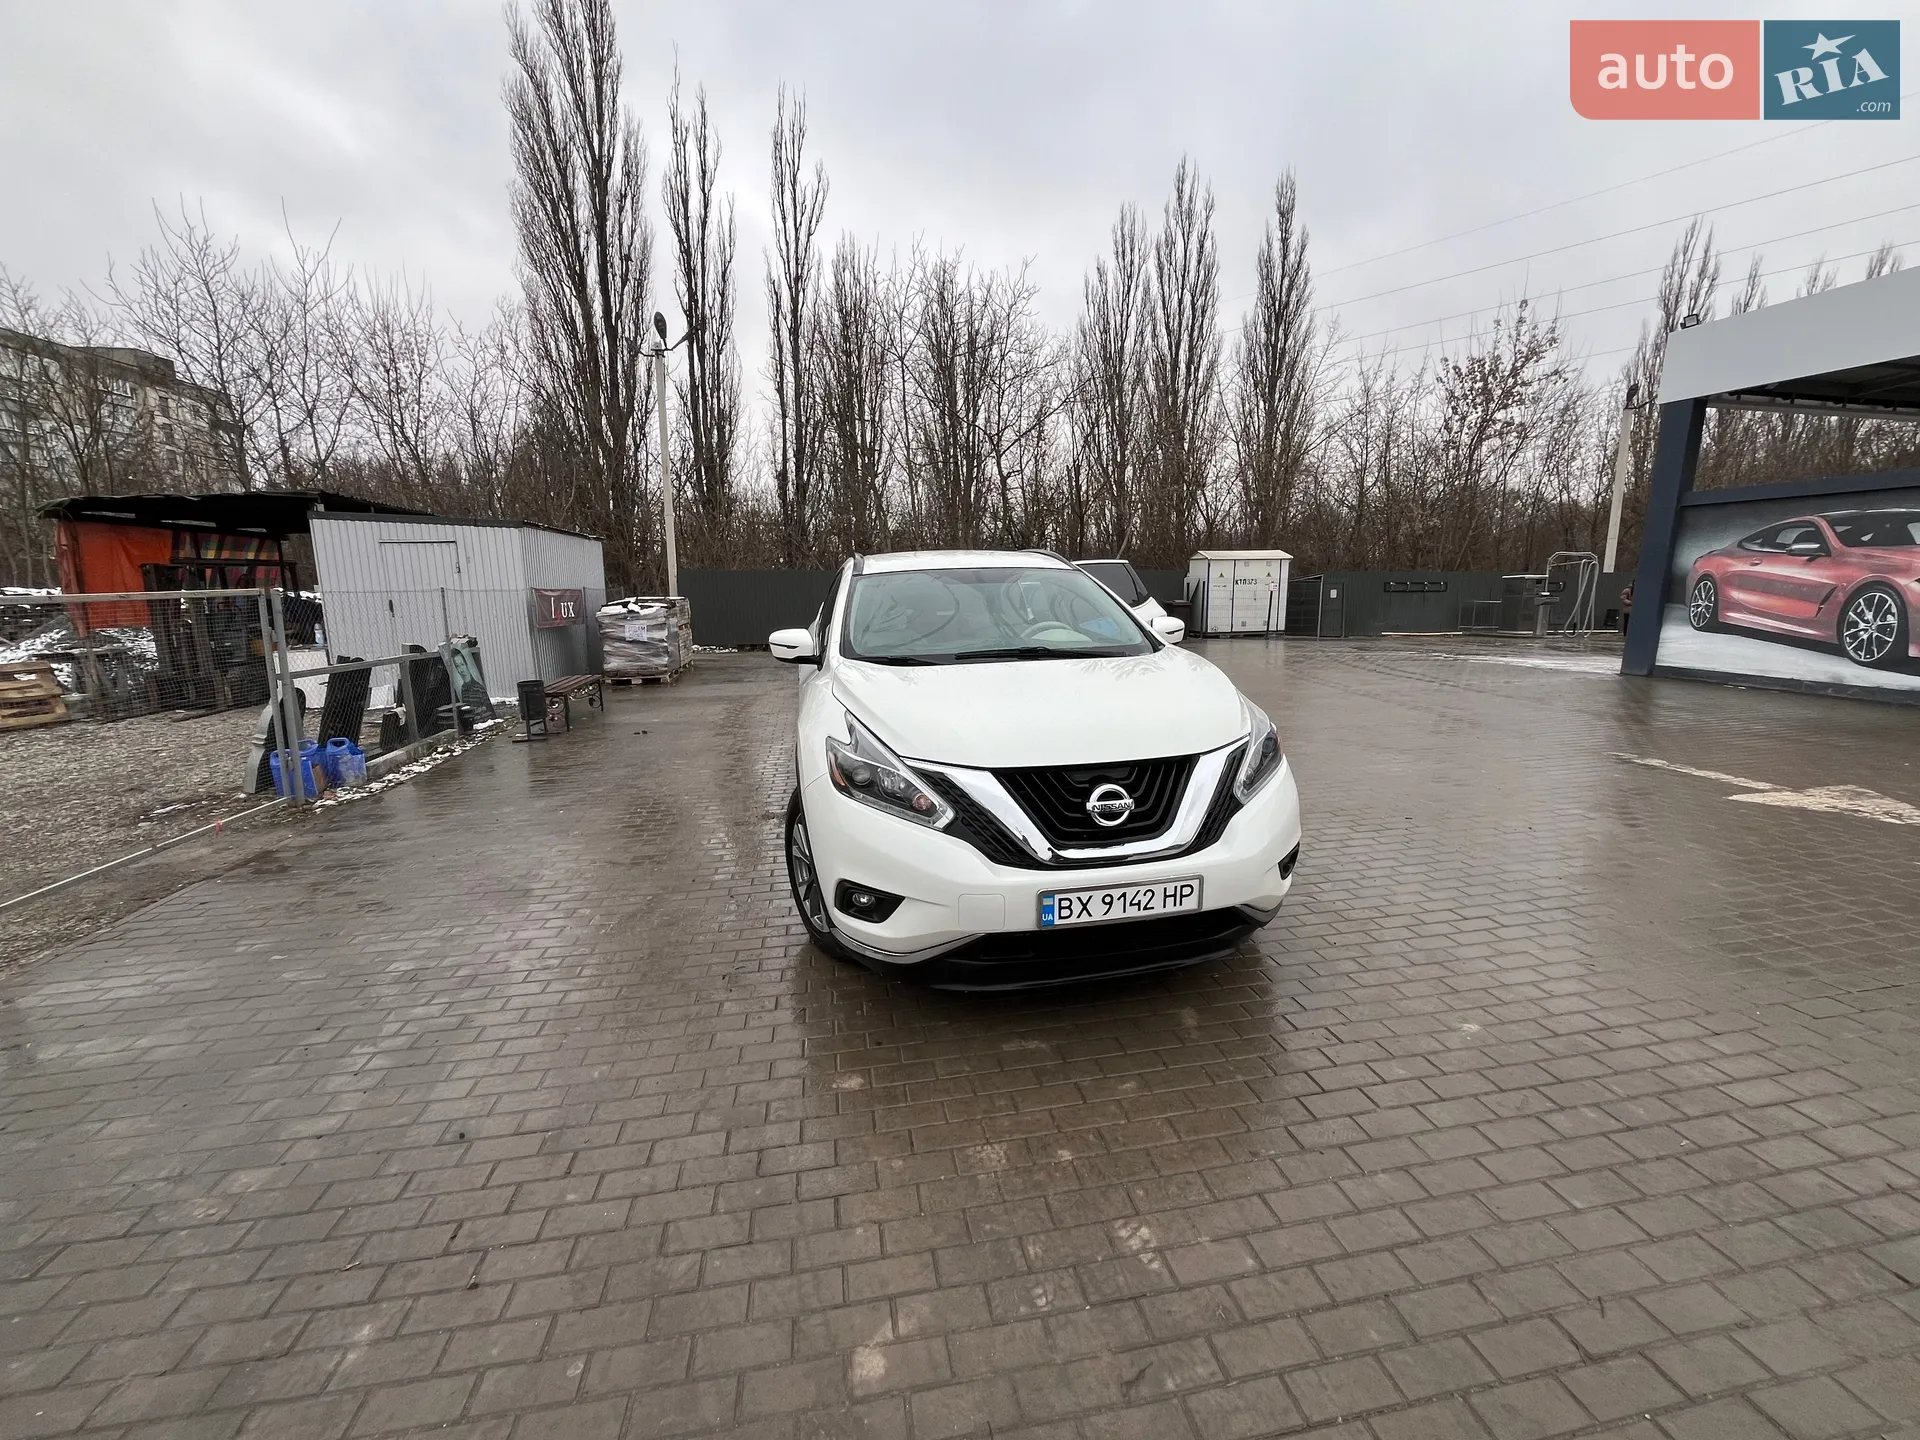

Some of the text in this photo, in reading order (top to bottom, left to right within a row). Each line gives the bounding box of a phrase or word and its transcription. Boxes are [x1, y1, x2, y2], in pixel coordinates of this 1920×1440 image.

[1091, 802, 1131, 812] NISSAN
[1057, 883, 1195, 920] BX 9142 HP
[1042, 913, 1054, 921] UA
